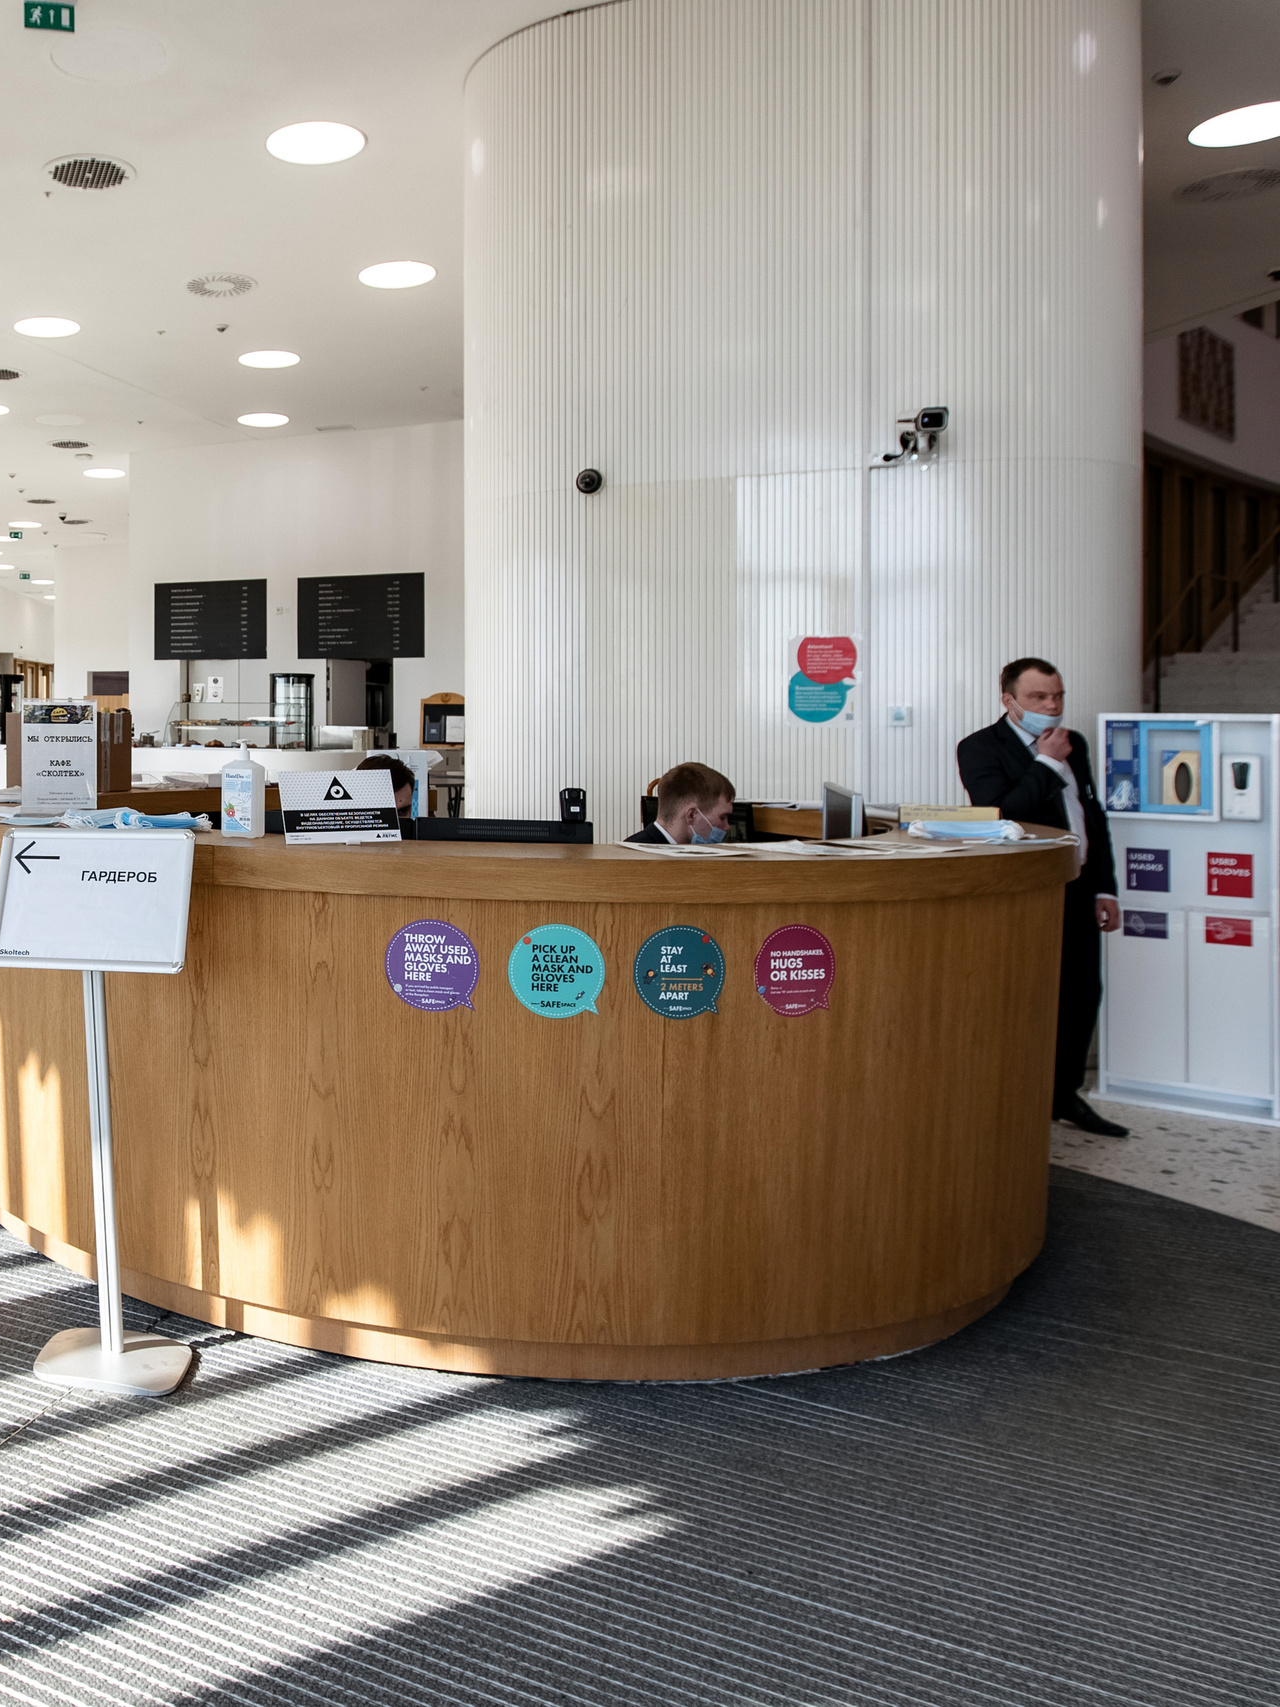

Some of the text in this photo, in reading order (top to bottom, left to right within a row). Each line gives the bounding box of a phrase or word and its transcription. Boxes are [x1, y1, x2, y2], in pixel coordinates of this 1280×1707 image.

[1130, 853, 1155, 862] USED
[1210, 858, 1238, 866] USED
[1129, 863, 1164, 872] MASKS
[1209, 867, 1251, 877] GLOVES
[81, 870, 157, 884] ГАРДЕРОБ
[404, 934, 446, 944] THROW
[404, 943, 468, 955] AWAY USED
[532, 944, 576, 954] PICK UP
[660, 946, 684, 955] STAY
[404, 952, 472, 965] MASKS AND
[532, 954, 578, 964] A CLEAN
[660, 955, 673, 964] AT
[770, 958, 803, 969] HUGS
[404, 962, 447, 973] GLOVES
[532, 964, 593, 974] MASK AND
[660, 964, 688, 973] LEAST
[404, 971, 432, 981] HERE
[532, 973, 575, 983] GLOVES
[770, 968, 826, 982] OR KISSES
[532, 983, 559, 992] HERE
[660, 982, 704, 992] 2 METERS
[659, 992, 690, 1001] APART
